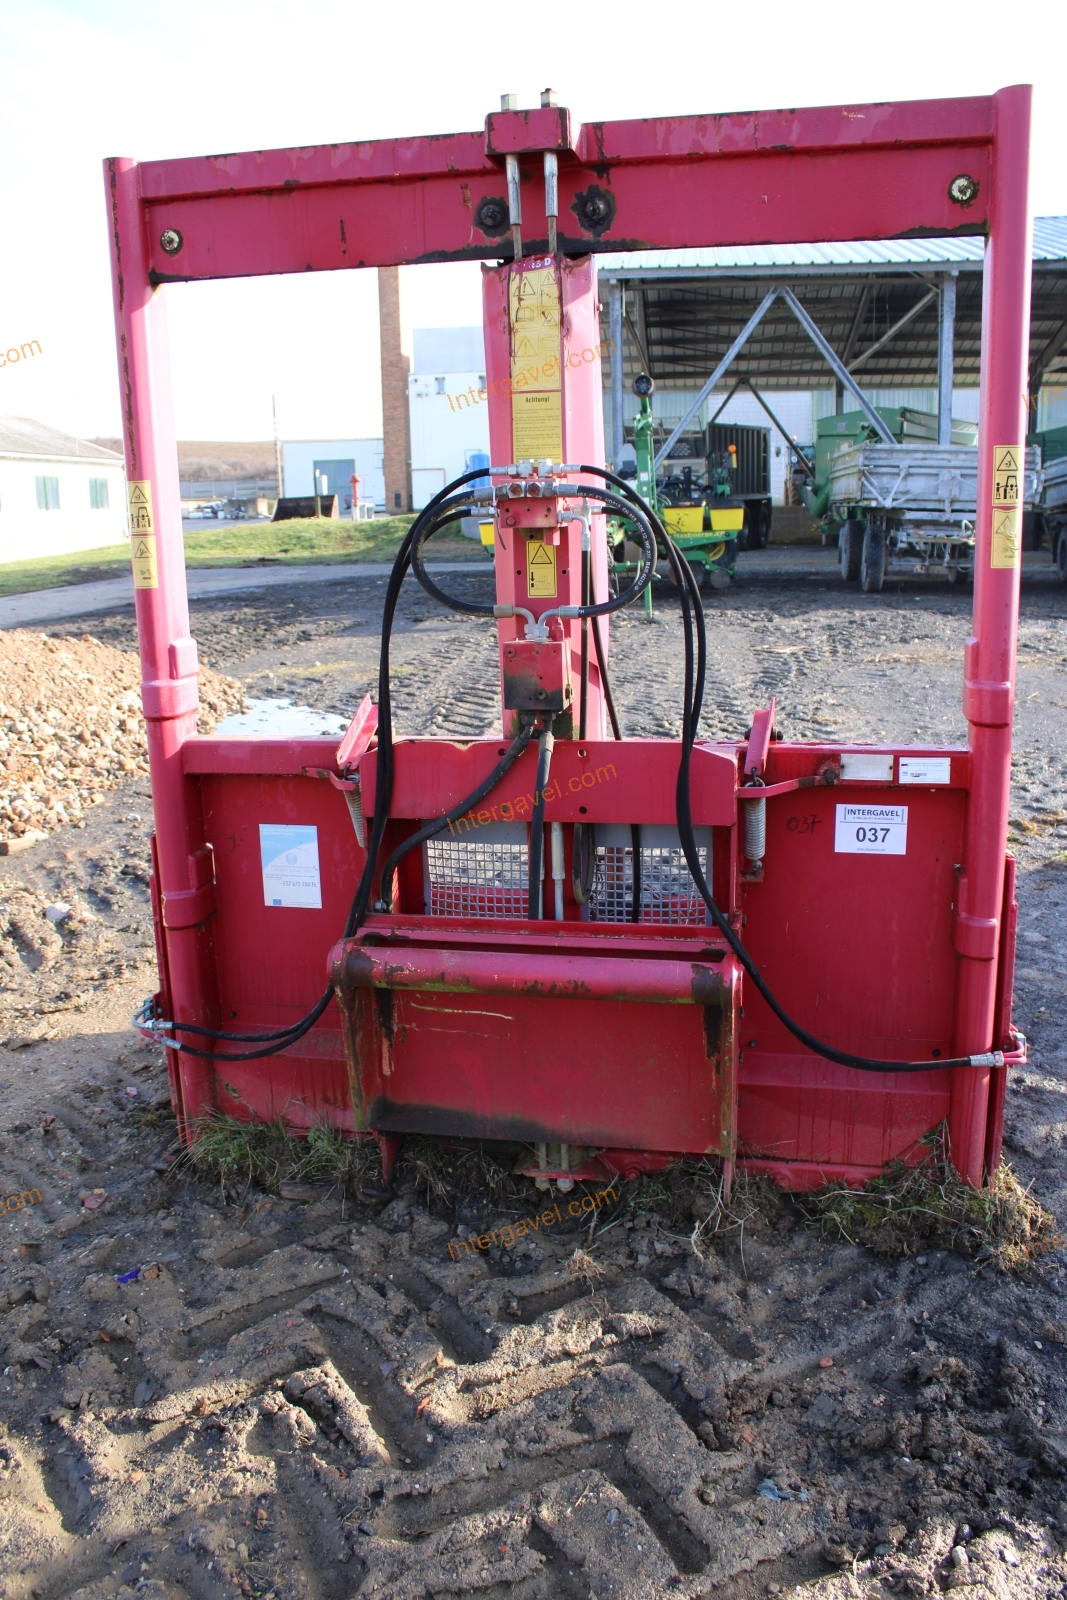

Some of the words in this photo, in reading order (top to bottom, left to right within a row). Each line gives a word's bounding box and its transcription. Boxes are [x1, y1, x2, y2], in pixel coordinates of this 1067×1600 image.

[644, 540, 651, 549] WP
[643, 561, 651, 573] BAR
[847, 808, 901, 817] INTERGAVEL
[785, 813, 823, 835] 037
[856, 827, 891, 843] 037
